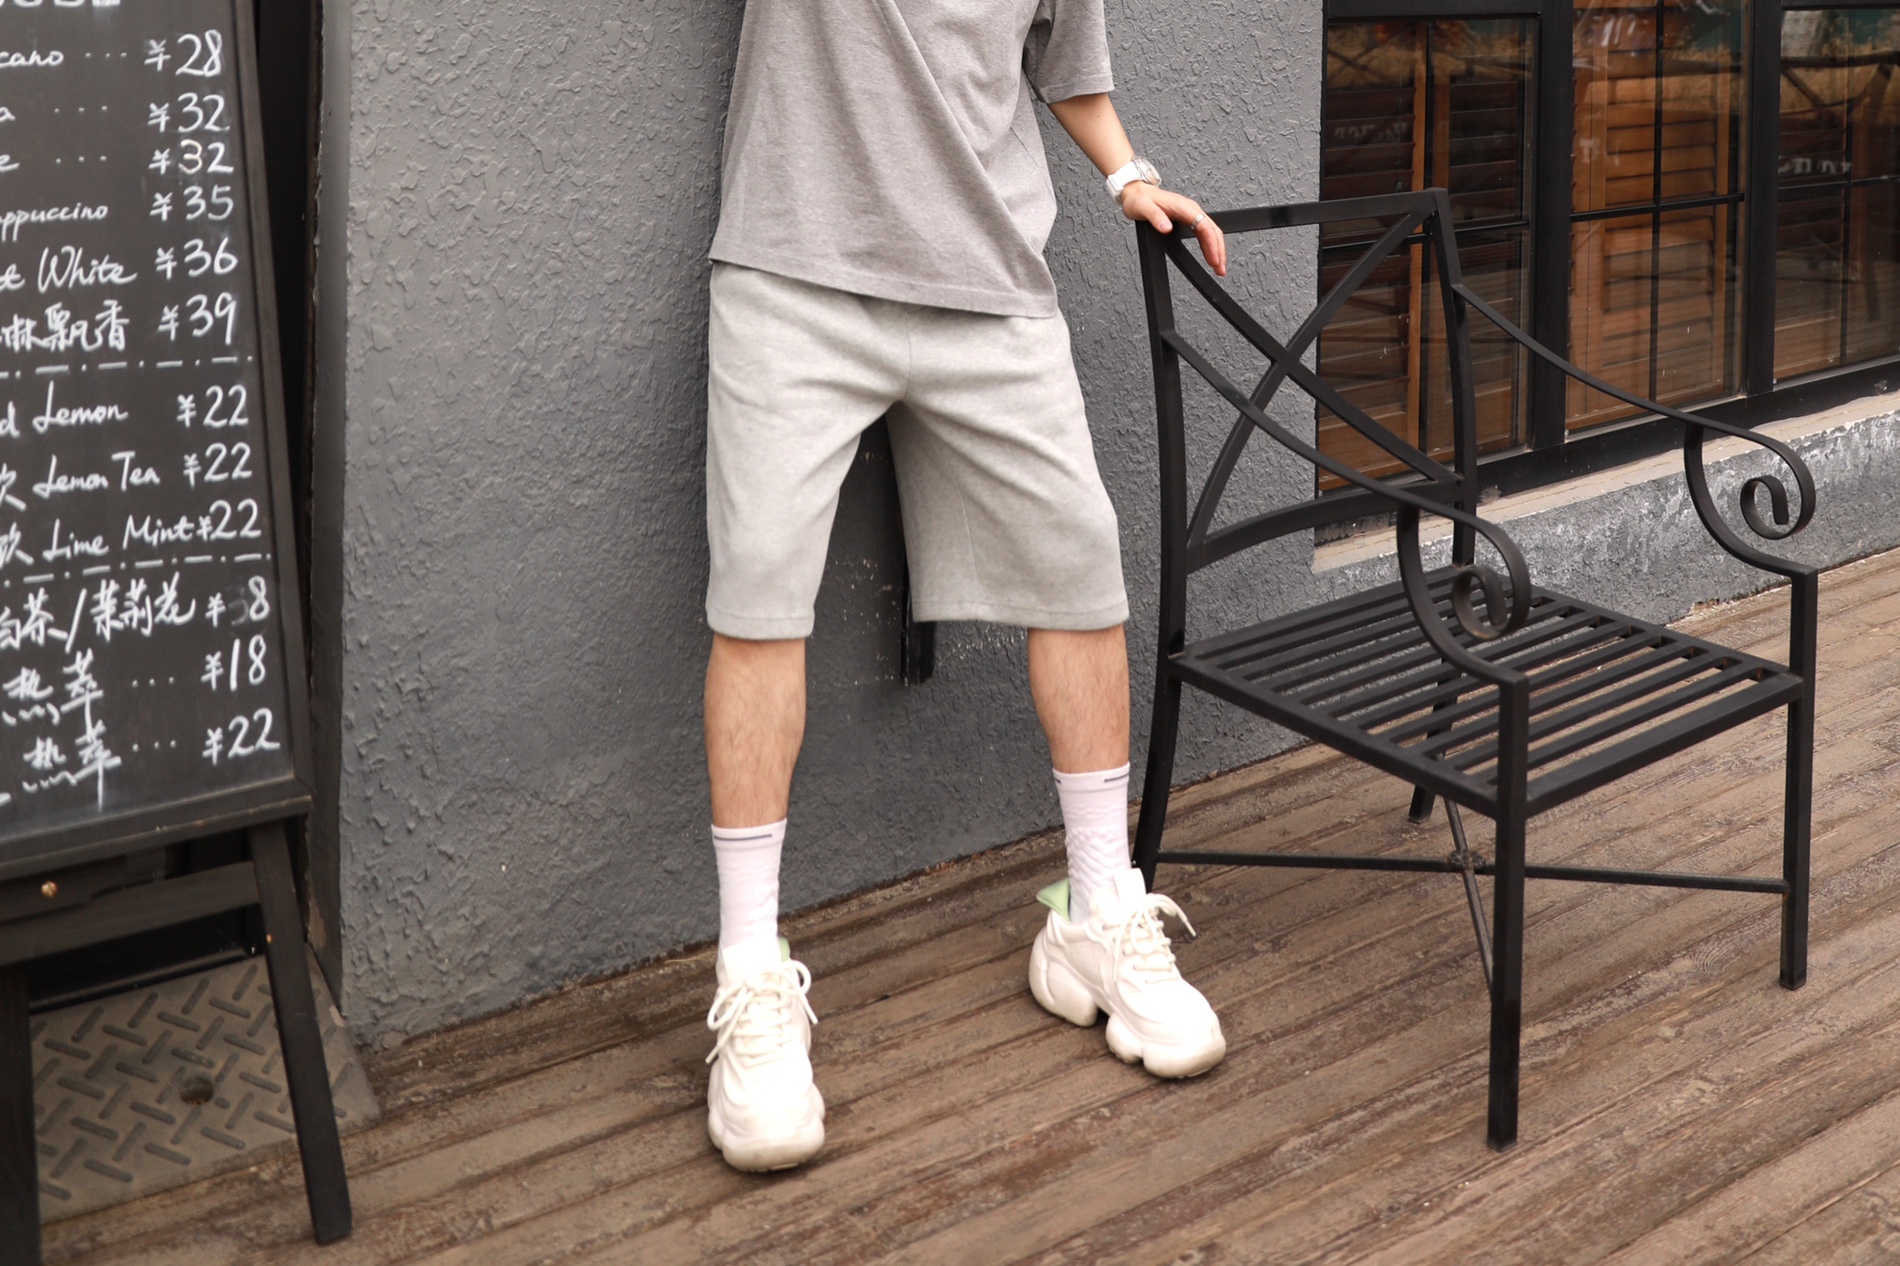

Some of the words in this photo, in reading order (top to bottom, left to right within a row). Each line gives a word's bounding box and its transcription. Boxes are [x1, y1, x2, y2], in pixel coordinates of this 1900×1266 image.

[144, 29, 223, 77] ¥28
[148, 92, 230, 133] ¥32
[148, 139, 234, 174] ¥32
[0, 202, 109, 242] ppuccino
[150, 184, 234, 222] ¥35
[37, 245, 138, 294] White
[155, 237, 239, 280] ¥36
[158, 292, 237, 346] ¥39
[32, 380, 129, 433] Lemon
[176, 384, 249, 428] ¥22
[32, 454, 109, 499] Lemon
[111, 450, 161, 491] Tea
[183, 442, 253, 488] ¥22
[122, 514, 195, 550] Mint
[196, 498, 262, 542] ¥22
[201, 634, 267, 691] ¥18
[202, 707, 280, 765] ¥22
